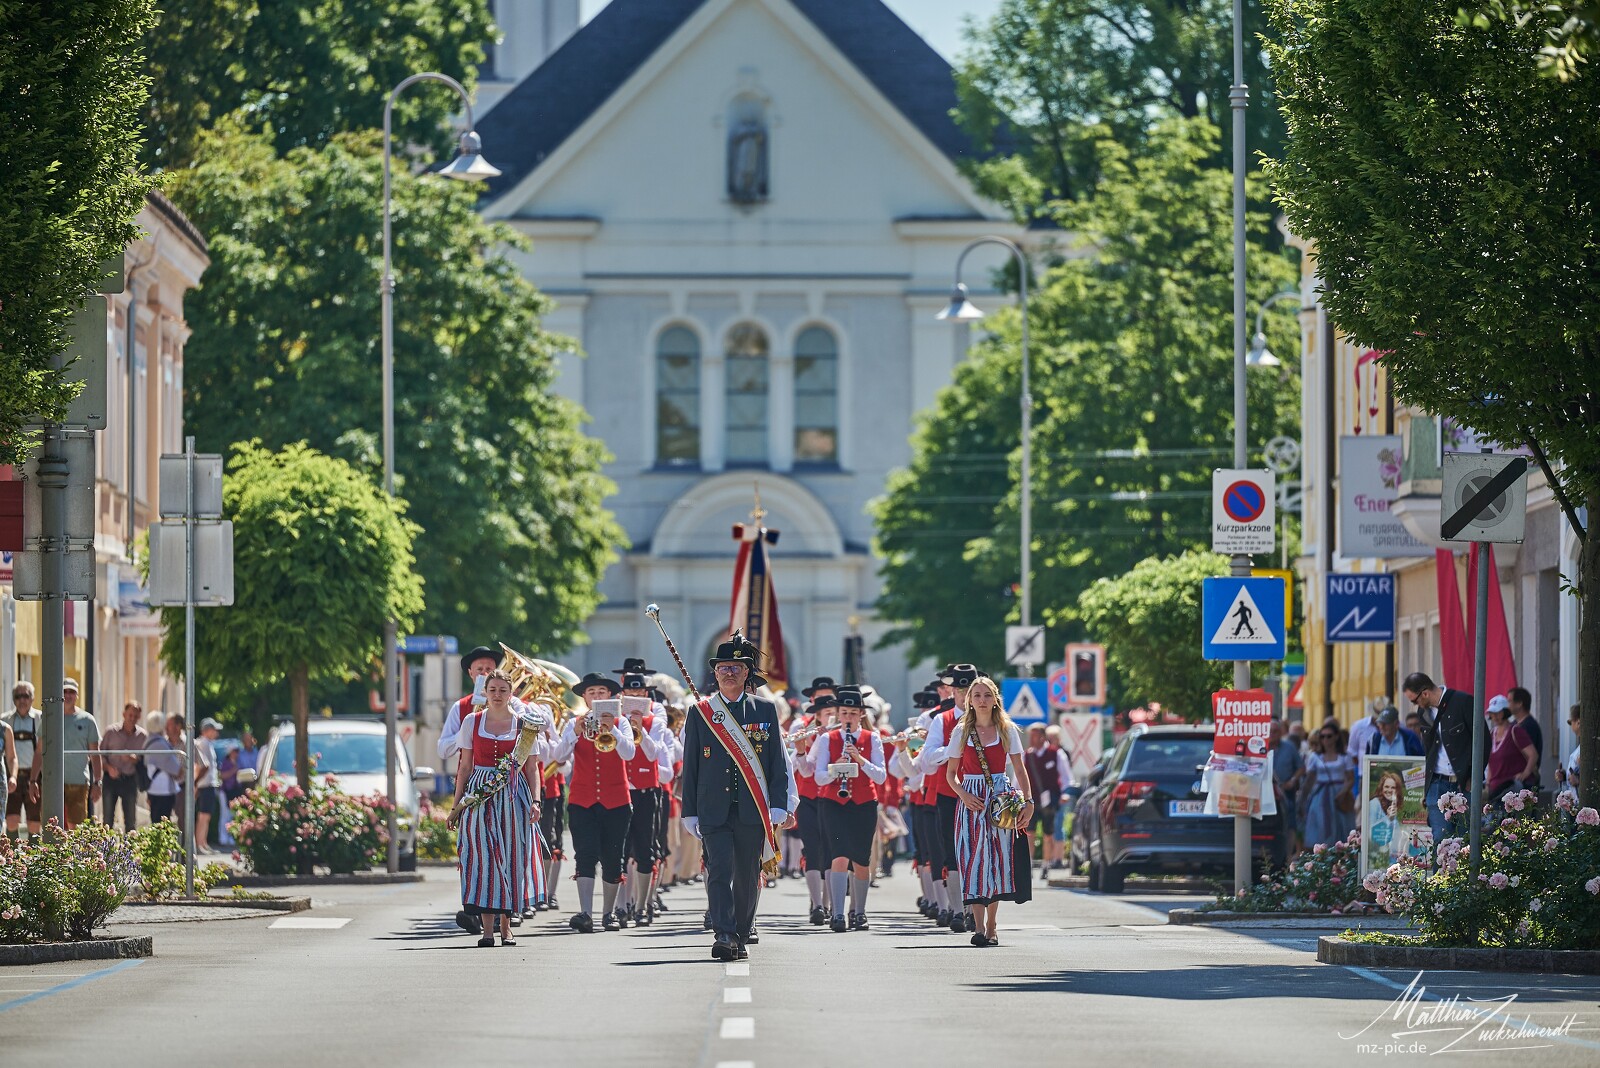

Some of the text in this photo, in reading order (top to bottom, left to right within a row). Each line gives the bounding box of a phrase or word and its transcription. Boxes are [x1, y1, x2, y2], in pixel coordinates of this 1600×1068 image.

[1216, 523, 1271, 534] Kurzparkzone
[1329, 577, 1392, 595] NOTAR
[1216, 697, 1271, 716] Kronen
[1216, 718, 1271, 739] Zeitung
